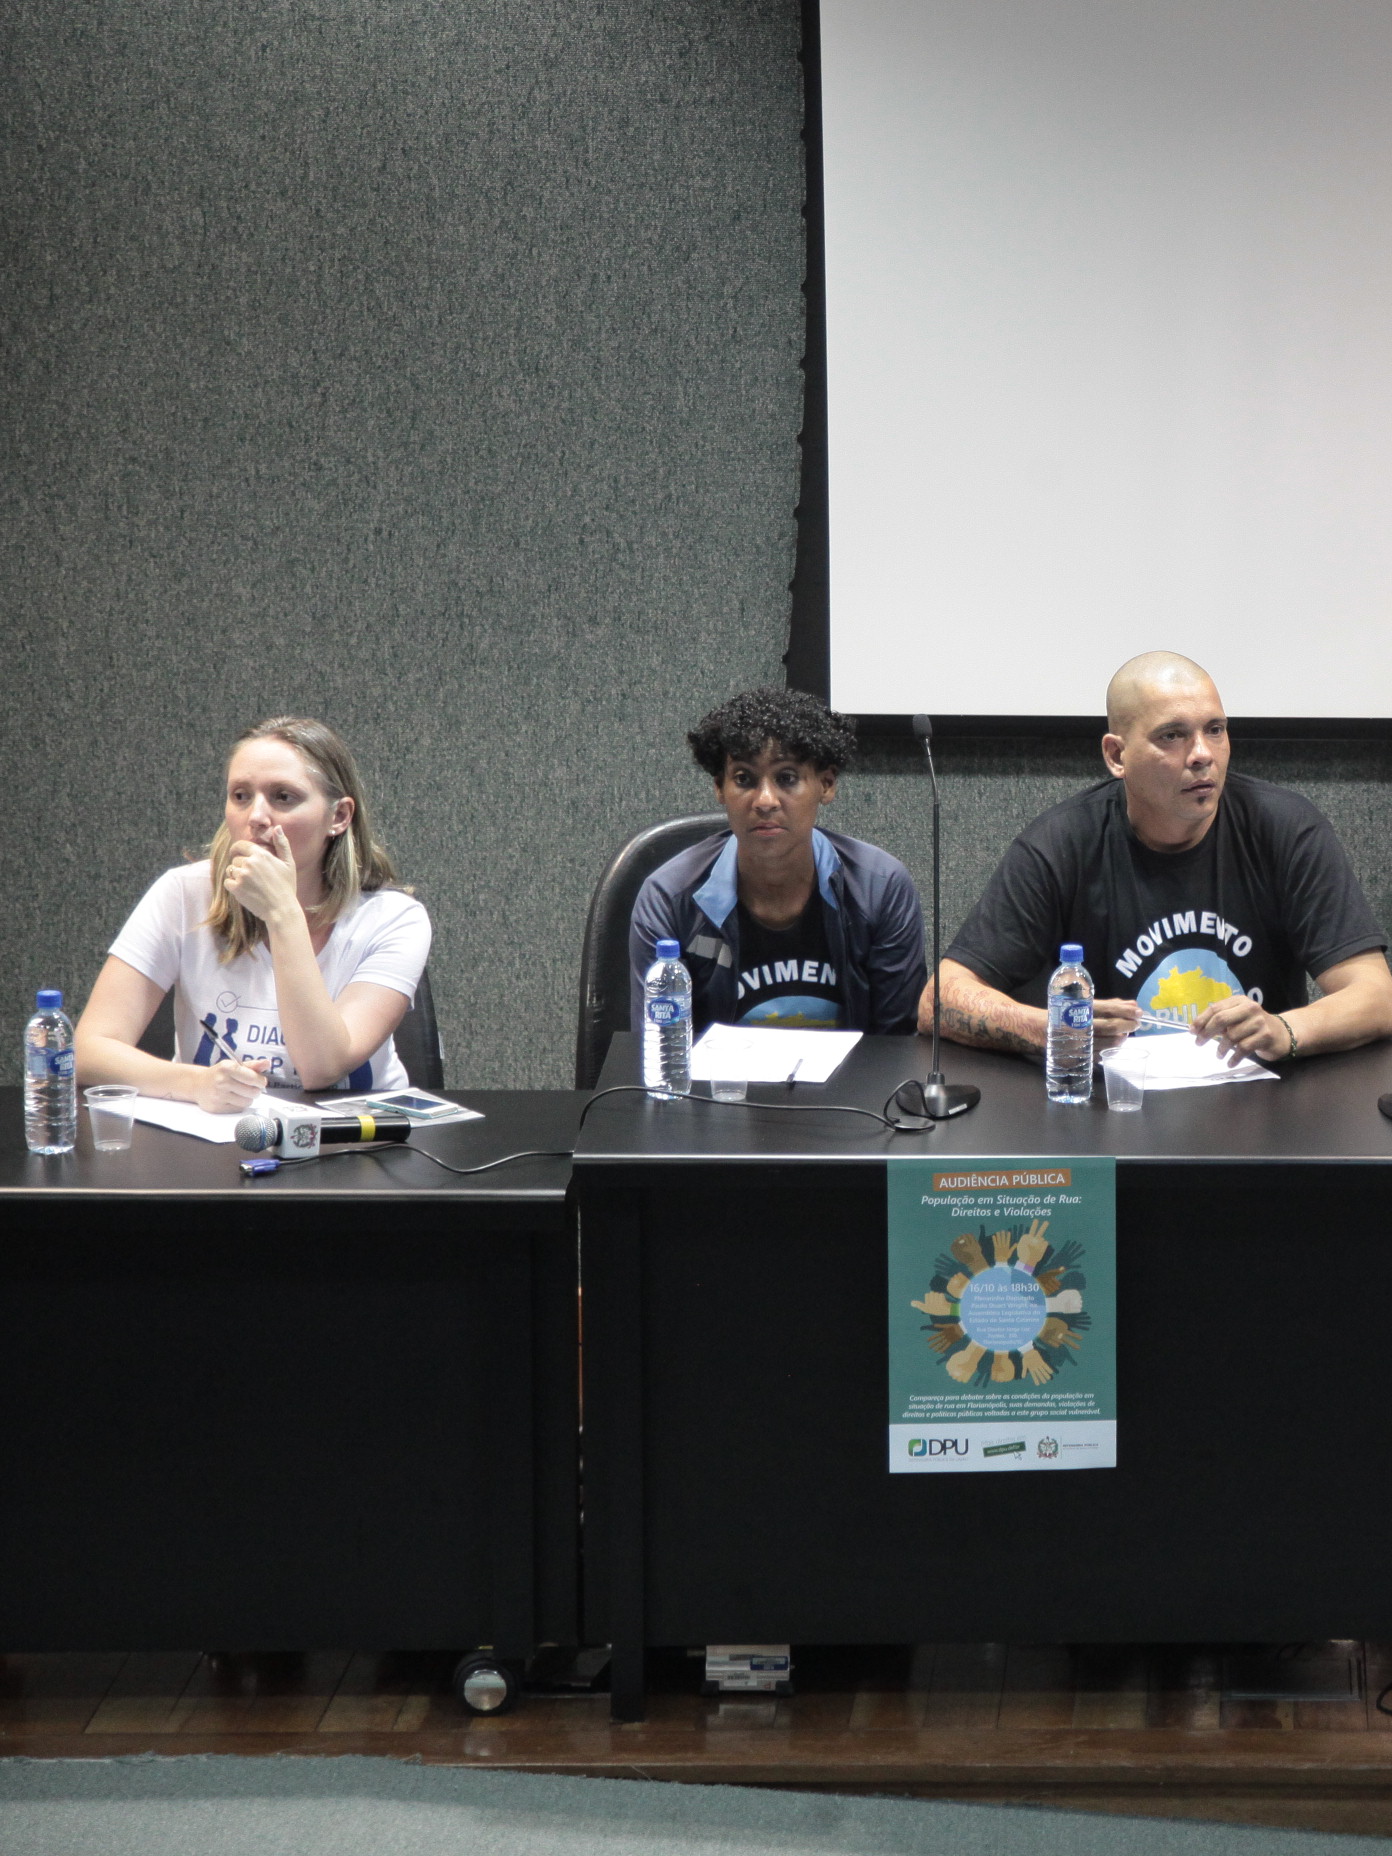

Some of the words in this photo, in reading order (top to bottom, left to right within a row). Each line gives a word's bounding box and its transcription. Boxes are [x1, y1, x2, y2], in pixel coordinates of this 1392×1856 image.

[1115, 911, 1253, 979] MOVIMENTO
[651, 1003, 675, 1013] SANTA
[1069, 1006, 1090, 1017] SANTA
[655, 1011, 672, 1019] RITA
[1073, 1014, 1088, 1022] RITA
[939, 1174, 1009, 1188] AUDIÊNCIA
[1012, 1172, 1065, 1186] PÚBLICA
[921, 1195, 975, 1207] População
[977, 1197, 994, 1205] em
[997, 1194, 1041, 1206] Situação
[1043, 1194, 1056, 1204] de
[1058, 1194, 1082, 1204] Rua:
[951, 1208, 991, 1217] Direitos
[1003, 1207, 1052, 1218] Violações
[970, 1283, 995, 1293] 16/10
[1010, 1283, 1040, 1292] 18h30
[909, 1394, 944, 1402] Compareça
[1011, 1393, 1040, 1401] condições
[1051, 1393, 1083, 1401] população
[908, 1403, 935, 1411] situação
[968, 1402, 1007, 1410] Florianópolis,
[1058, 1401, 1086, 1409] violações
[931, 1410, 957, 1419] políticas
[958, 1410, 983, 1418] públicas
[928, 1438, 969, 1456] DPU
